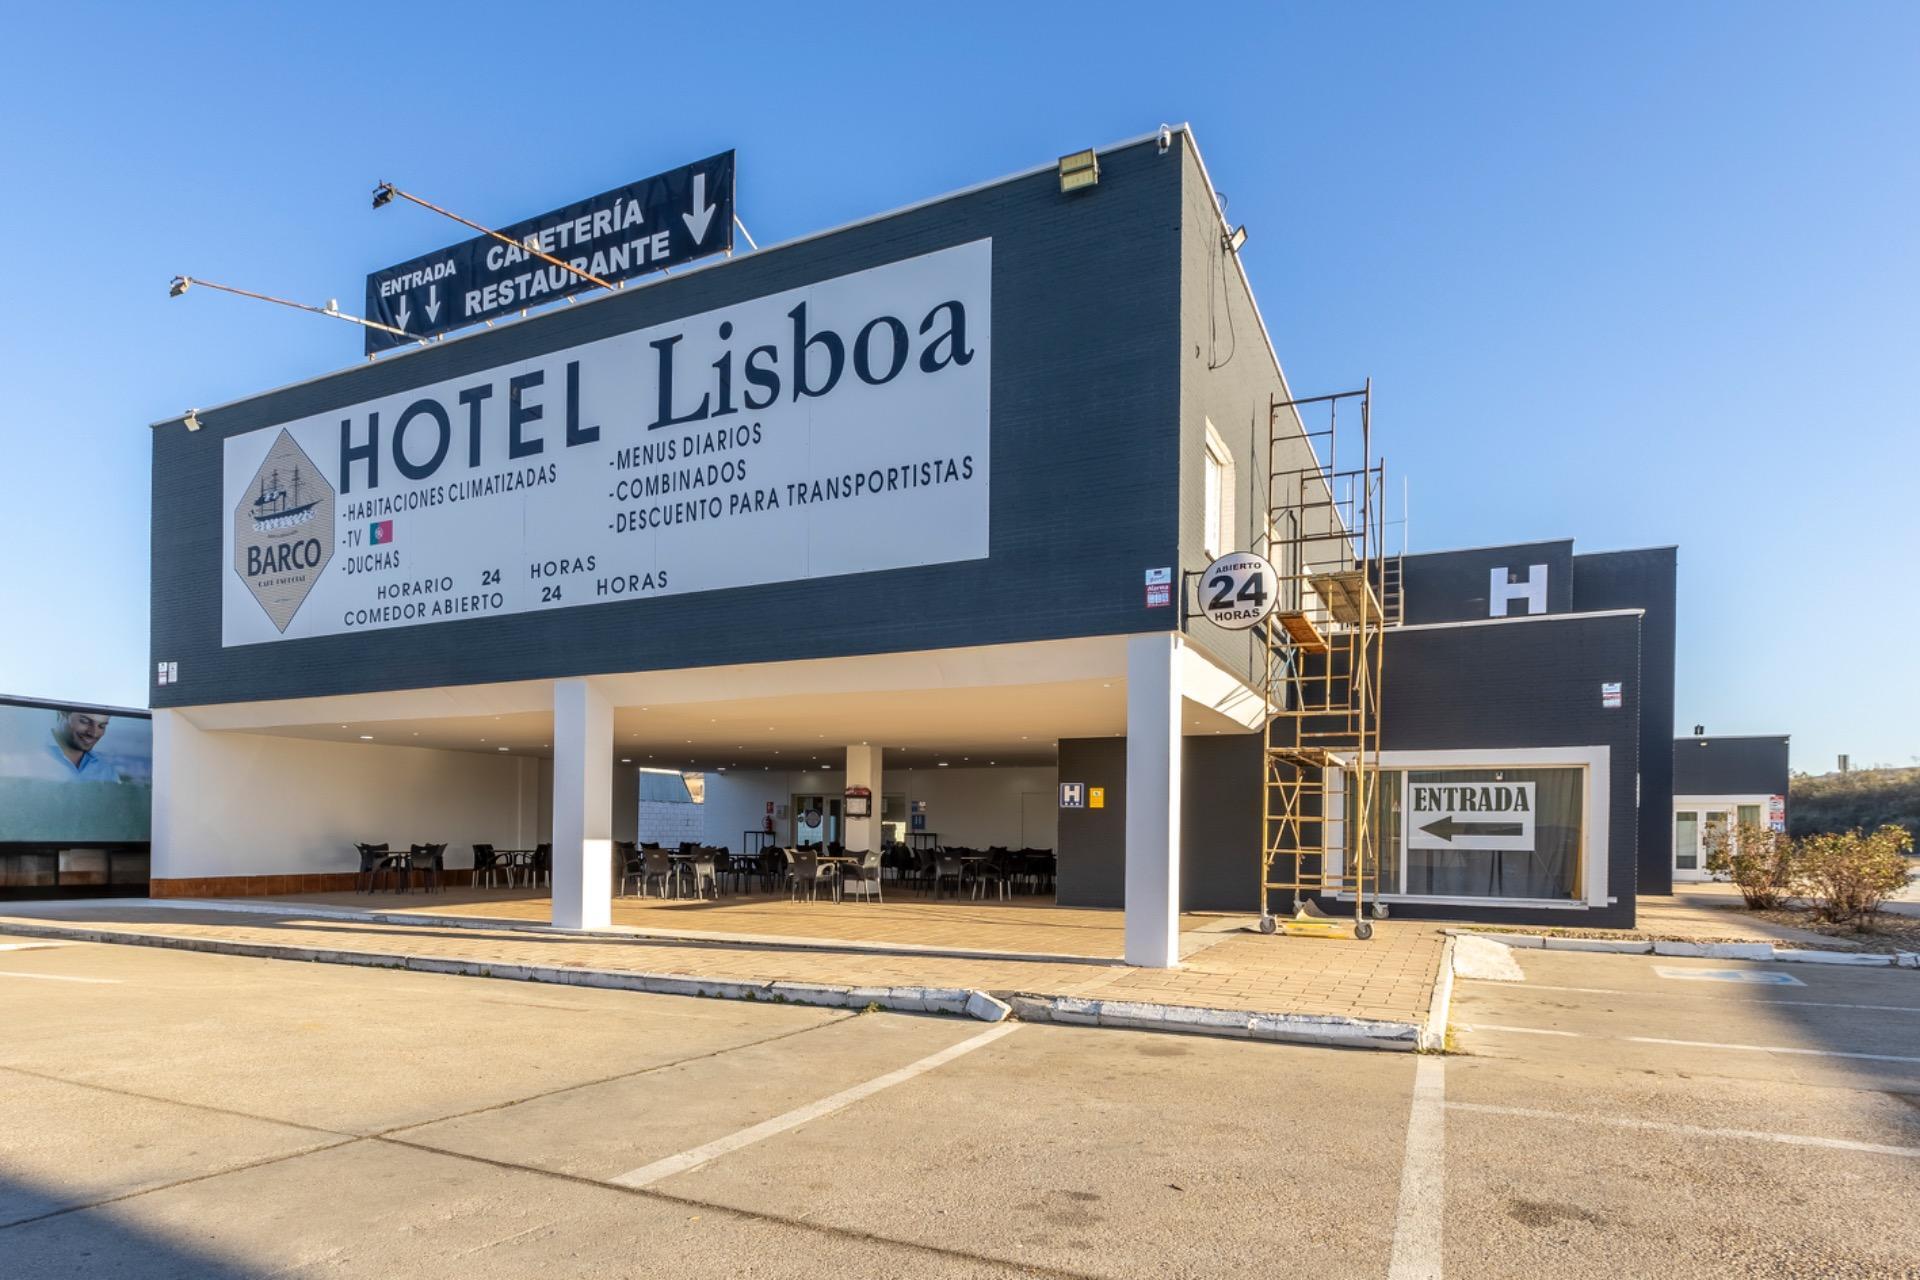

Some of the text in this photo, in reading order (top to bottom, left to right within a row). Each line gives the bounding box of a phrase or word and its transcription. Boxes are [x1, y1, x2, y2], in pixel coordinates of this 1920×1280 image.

[381, 259, 457, 298] ENTRADA
[465, 231, 670, 316] RESTAURANTE
[340, 300, 975, 494] HOTEL Lisboa
[609, 422, 762, 471] -MENUS DIARIOS
[342, 463, 557, 522] -HABITACIONES CLIMATIZADAS
[608, 455, 973, 533] -DESCUENTO PARA TRANSPORTISTAS
[609, 459, 746, 502] -COMBINADOS
[247, 538, 321, 577] BARCO
[342, 529, 361, 548] -TV
[342, 550, 400, 575] -DUCHAS
[377, 555, 597, 600] HORARIO 24 HORAS
[1215, 562, 1261, 575] ABIERTO
[344, 570, 668, 626] COMEDOR ABIERTO 24 HORAS
[1208, 571, 1267, 611] 24
[1489, 564, 1548, 617] H
[1215, 608, 1260, 621] HORAS
[1413, 787, 1530, 812] ENTRADA
